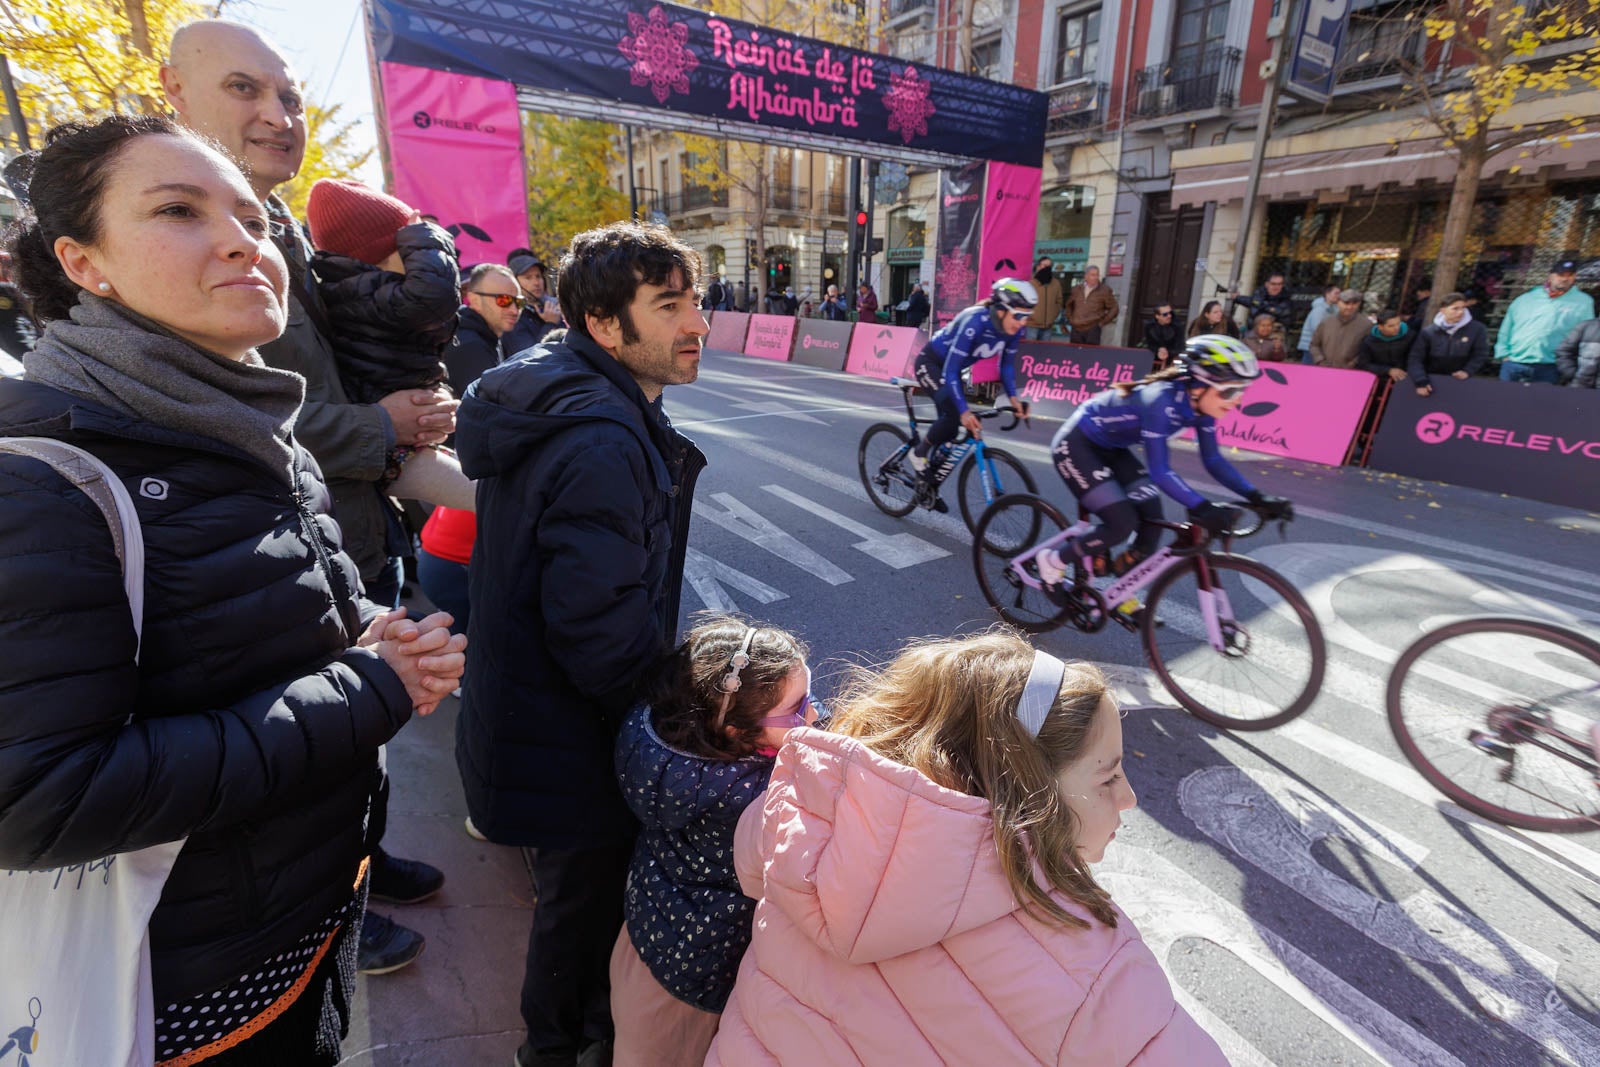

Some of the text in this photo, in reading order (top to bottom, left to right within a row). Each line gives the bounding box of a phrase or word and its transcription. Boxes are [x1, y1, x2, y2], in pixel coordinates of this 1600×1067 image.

[706, 19, 877, 96] Reinäs de lä
[433, 118, 497, 134] RELEVO
[812, 338, 840, 349] RELEVO
[1020, 355, 1082, 380] Reinäs
[1085, 362, 1111, 381] de
[1020, 379, 1108, 406] Alhämb
[1216, 420, 1290, 450] ndalucía
